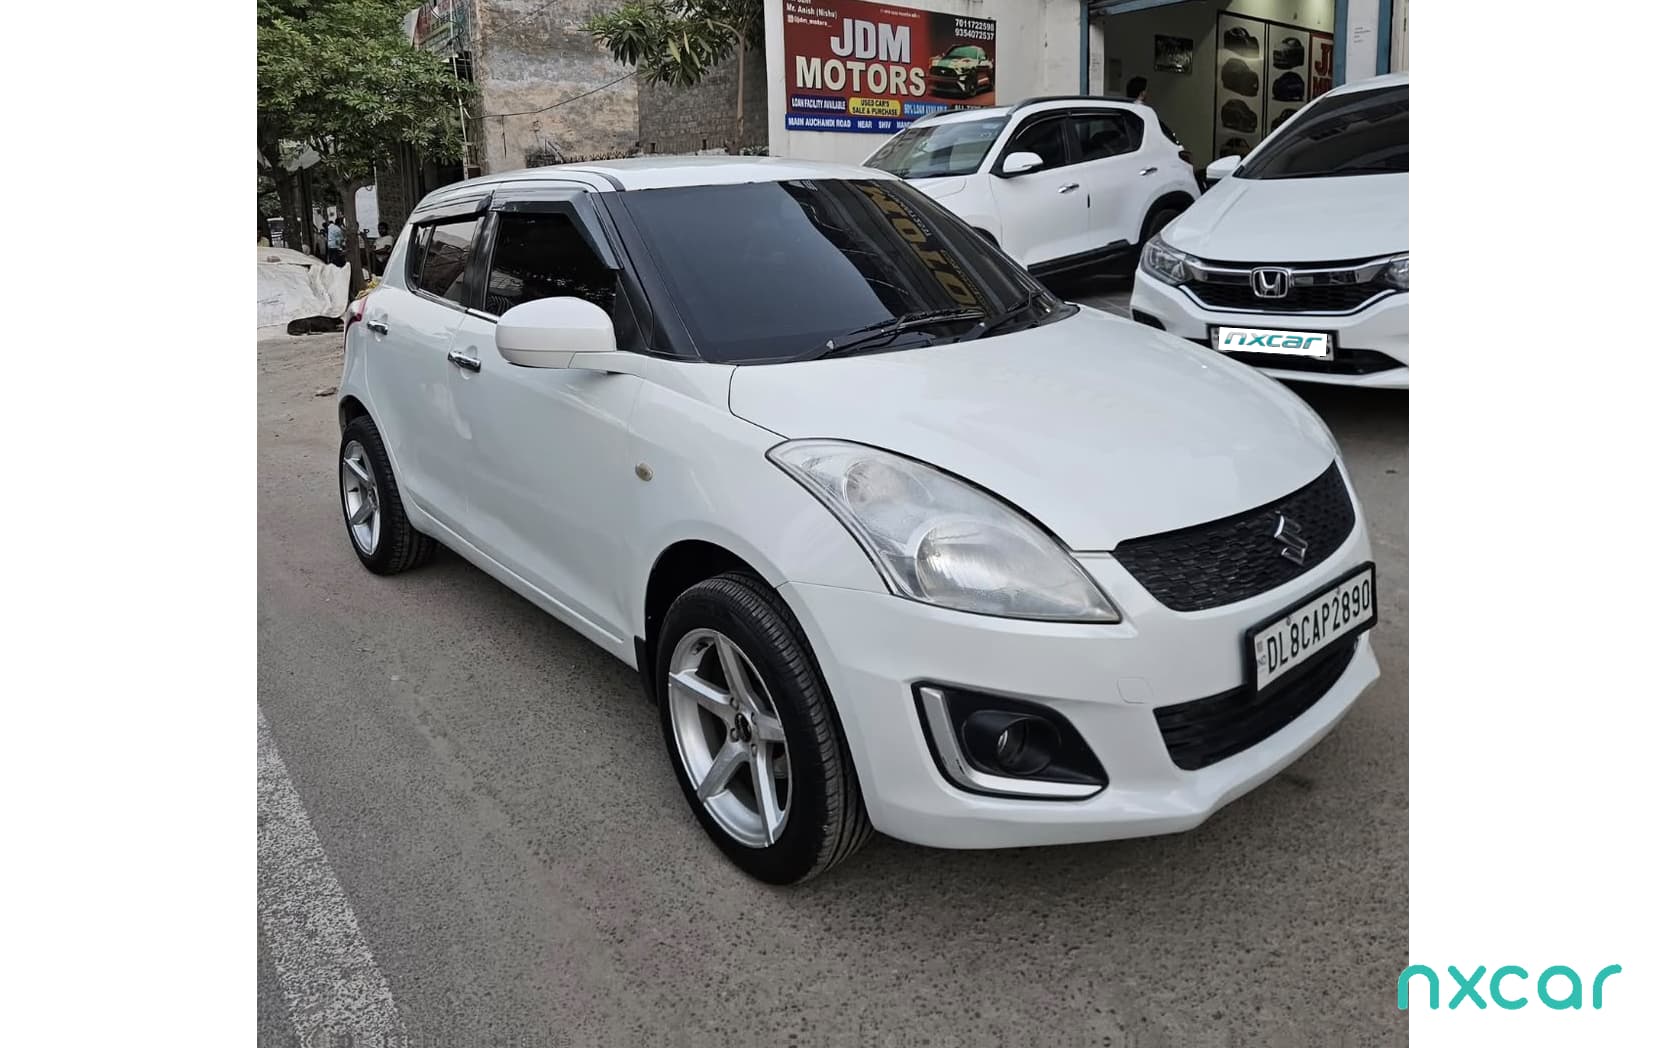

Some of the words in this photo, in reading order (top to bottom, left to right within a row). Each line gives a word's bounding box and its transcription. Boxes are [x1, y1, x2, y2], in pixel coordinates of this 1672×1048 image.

[787, 2, 796, 12] Mr.
[798, 5, 815, 15] Anish
[830, 18, 911, 63] JDM
[795, 55, 926, 97] MOTORS
[792, 98, 803, 108] LOAN
[805, 99, 824, 109] FACILITY
[914, 104, 925, 115] LOAN
[788, 118, 804, 126] MAIN
[836, 119, 851, 128] ROAD
[858, 120, 872, 128] NEAR
[1267, 579, 1370, 674] DL8CAP2890
